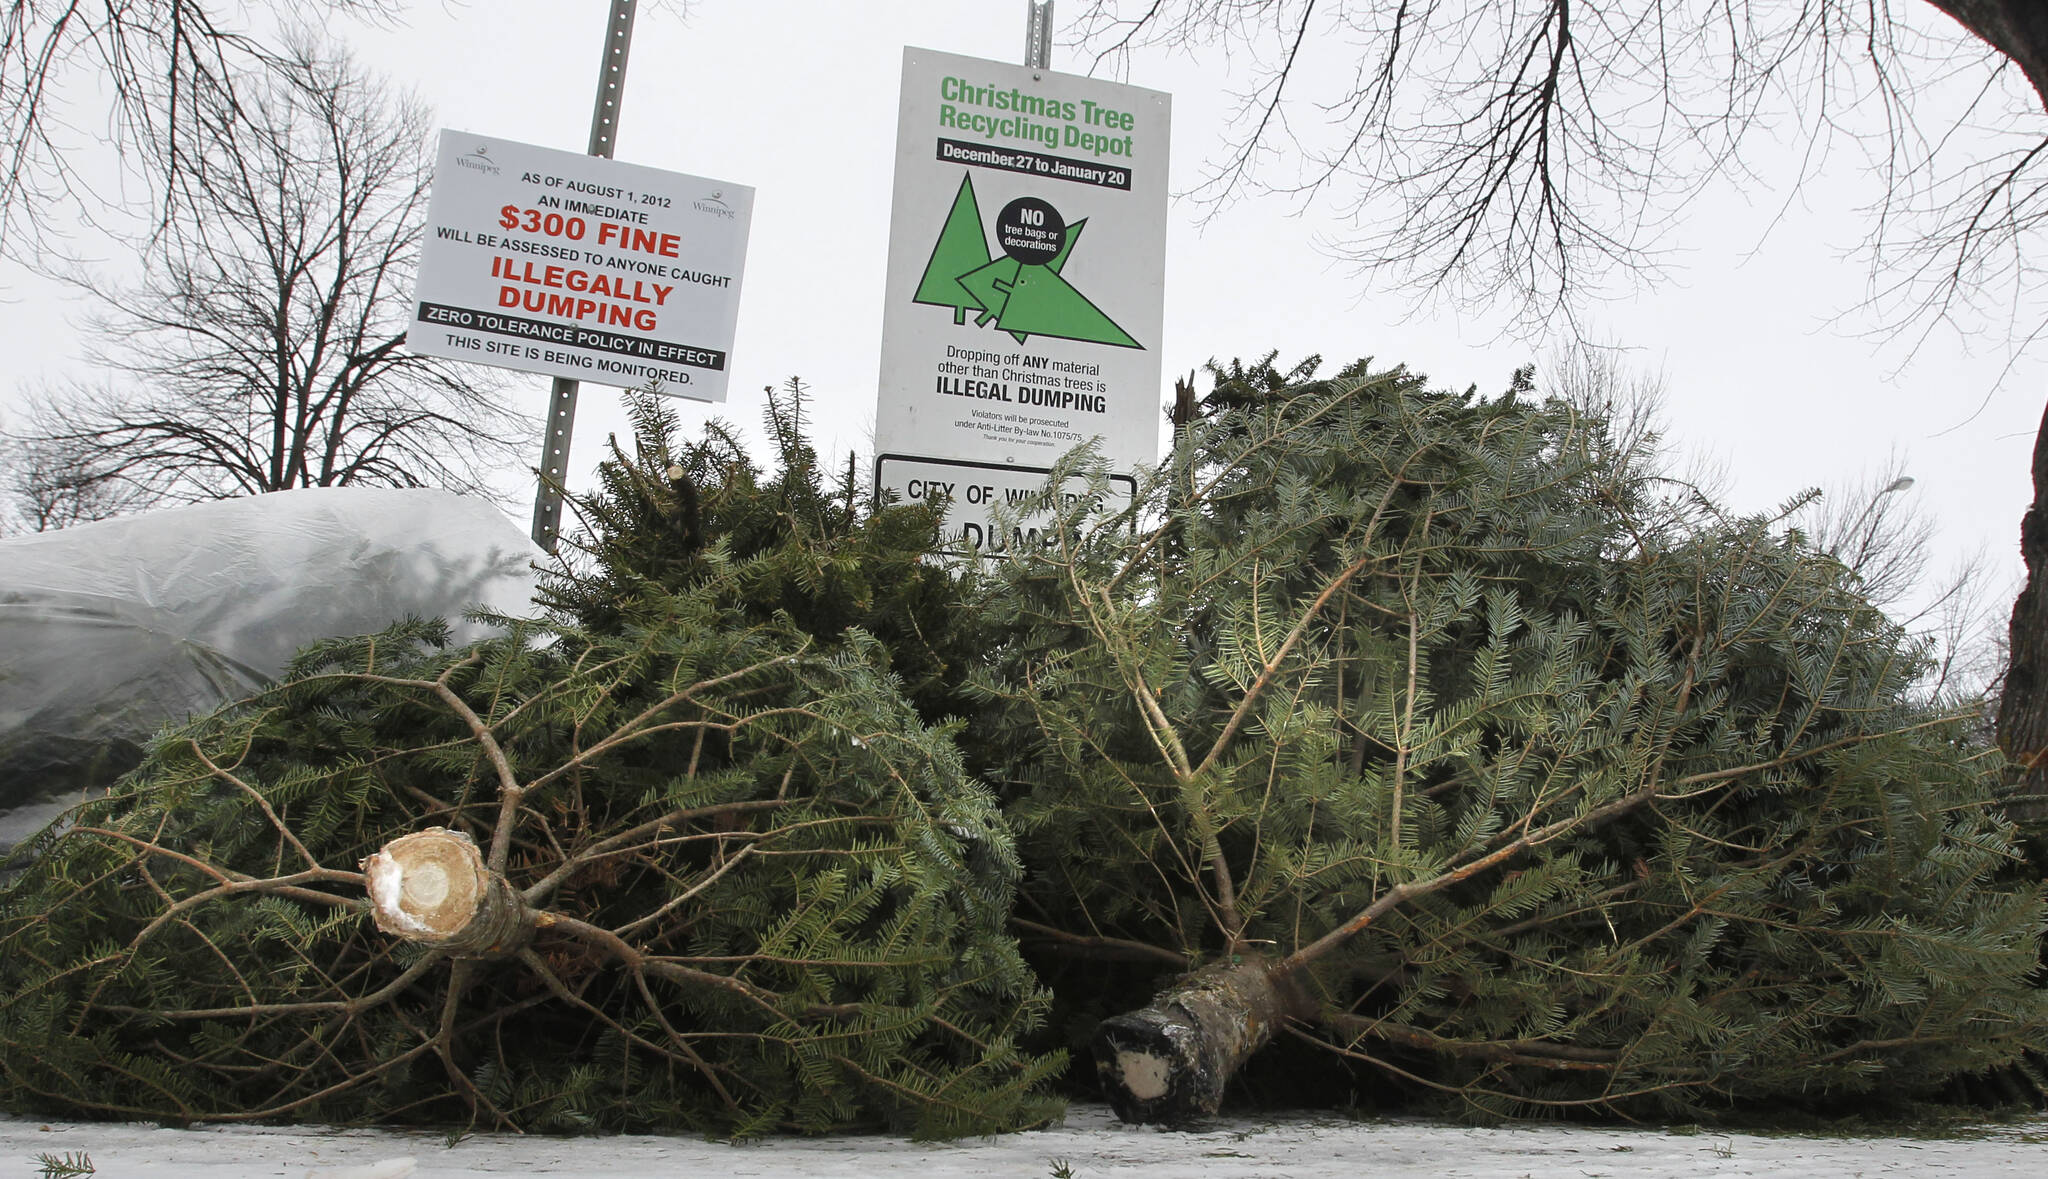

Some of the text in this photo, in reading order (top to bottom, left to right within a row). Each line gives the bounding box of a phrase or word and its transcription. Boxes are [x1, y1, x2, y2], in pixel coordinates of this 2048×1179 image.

[941, 76, 1135, 131] Christmas Tree
[940, 104, 1133, 157] Recycling Depot
[456, 157, 500, 175] Winnipeg
[1016, 155, 1034, 169] 27
[1035, 158, 1049, 172] to
[1051, 161, 1106, 184] January
[1108, 171, 1125, 185] 20
[521, 172, 671, 208] AS OF AUGUST 1, 2012
[538, 195, 649, 225] AN IMMEDIATE
[692, 201, 735, 219] Winnipeg
[1020, 208, 1044, 226] NO
[498, 204, 681, 258] $300 FINE
[1004, 236, 1057, 252] decorations
[1005, 224, 1058, 240] tree bags or
[437, 226, 731, 288] WILL BE ASSESSED TO ANYONE CAUGHT
[491, 256, 674, 306] ILLEGALLY
[498, 286, 657, 331] DUMPING
[427, 307, 717, 365] ZERO TOLERANCE POLICY IN EFFECT
[446, 334, 693, 385] THIS SITE IS BEING MONITORED.
[947, 345, 1099, 376] Dropping off ANY material
[938, 362, 1106, 392] other than Christmas trees is
[936, 376, 1106, 413] ILLEGAL DUMPING
[955, 420, 975, 429] under
[977, 422, 1012, 433] Anti-Litter
[1014, 426, 1039, 437] By-law
[971, 409, 1069, 429] Violators will be prosecuted
[983, 433, 997, 441] Thank
[908, 479, 955, 500] CITY
[966, 485, 994, 505] OF
